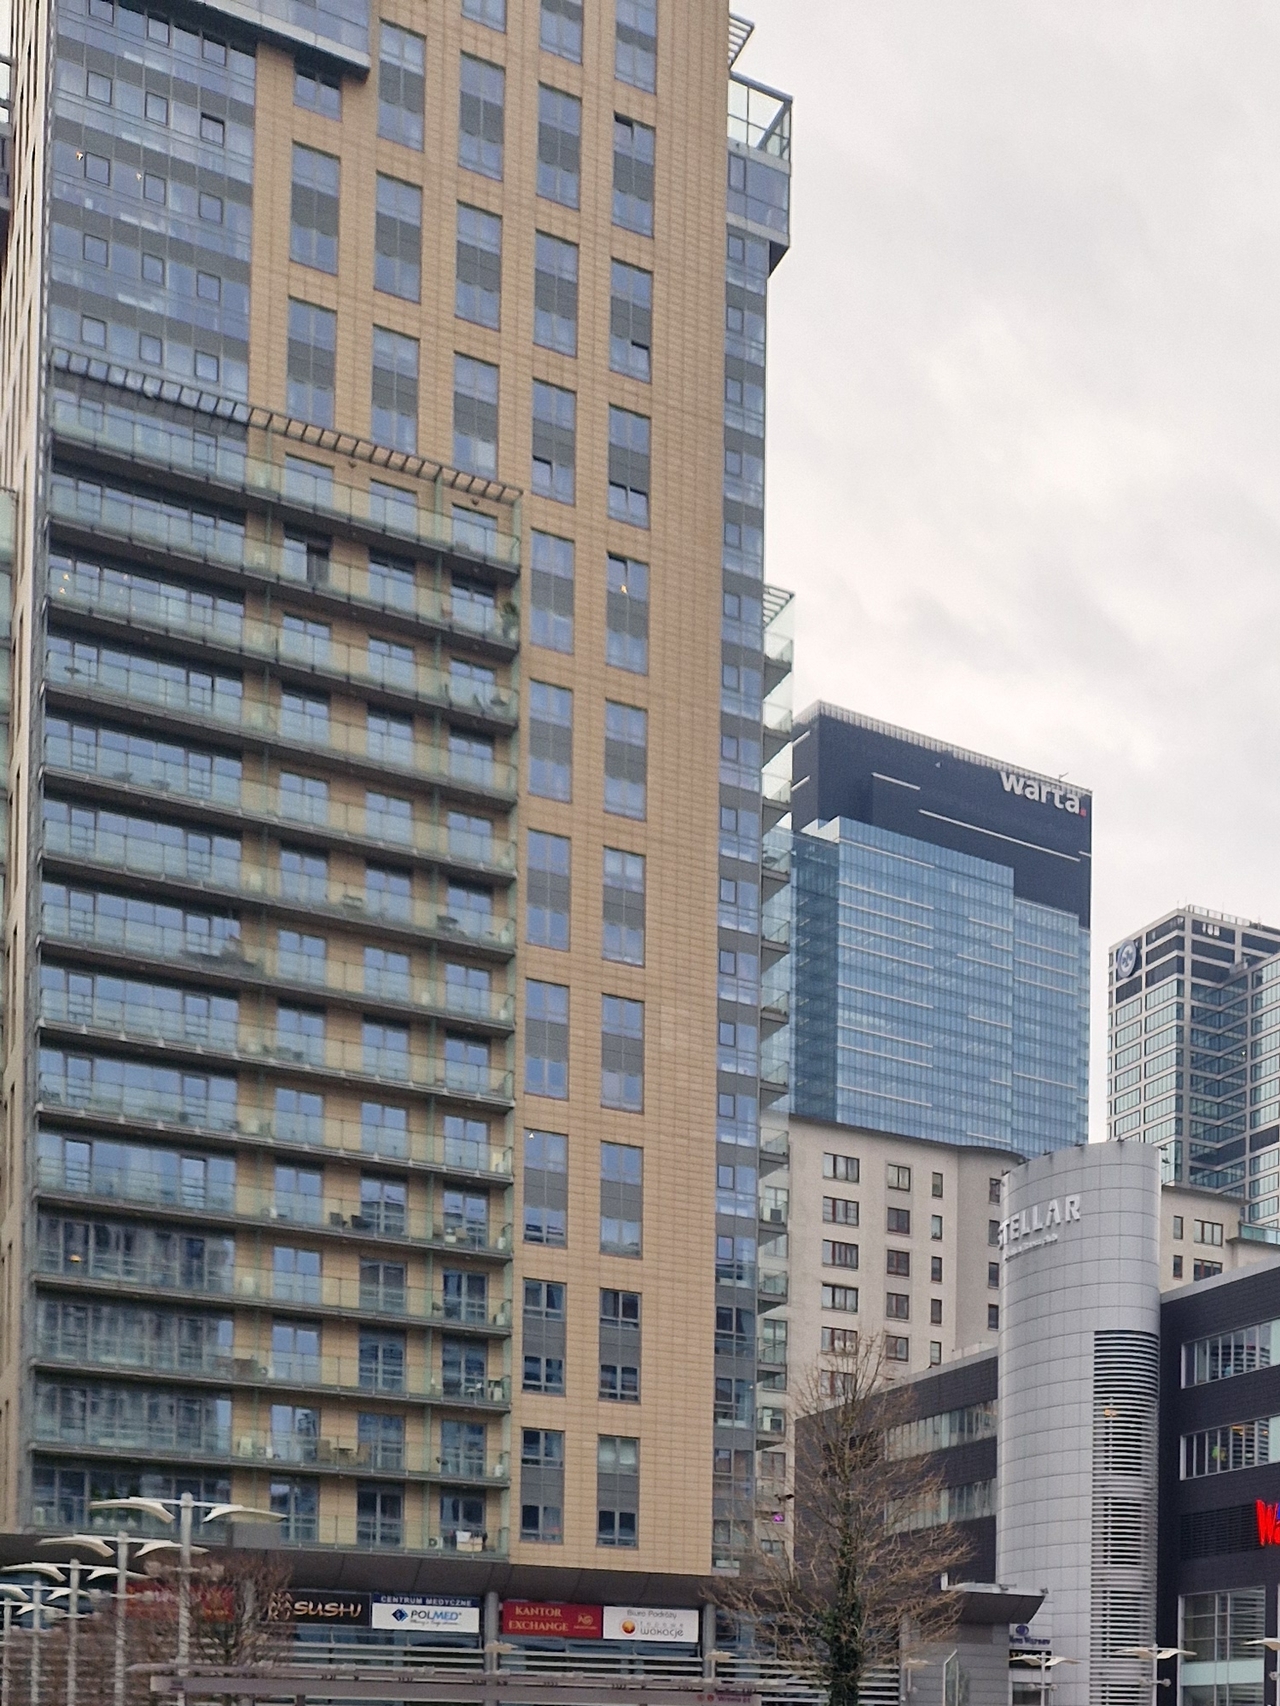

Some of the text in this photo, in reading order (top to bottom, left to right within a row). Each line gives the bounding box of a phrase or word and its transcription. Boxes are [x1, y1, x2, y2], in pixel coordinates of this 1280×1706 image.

[381, 1596, 472, 1606] CENTRUM MEDYCZNE
[515, 1605, 562, 1617] KANTOR
[626, 1609, 647, 1617] Biuro
[508, 1620, 569, 1631] EXCHANGE
